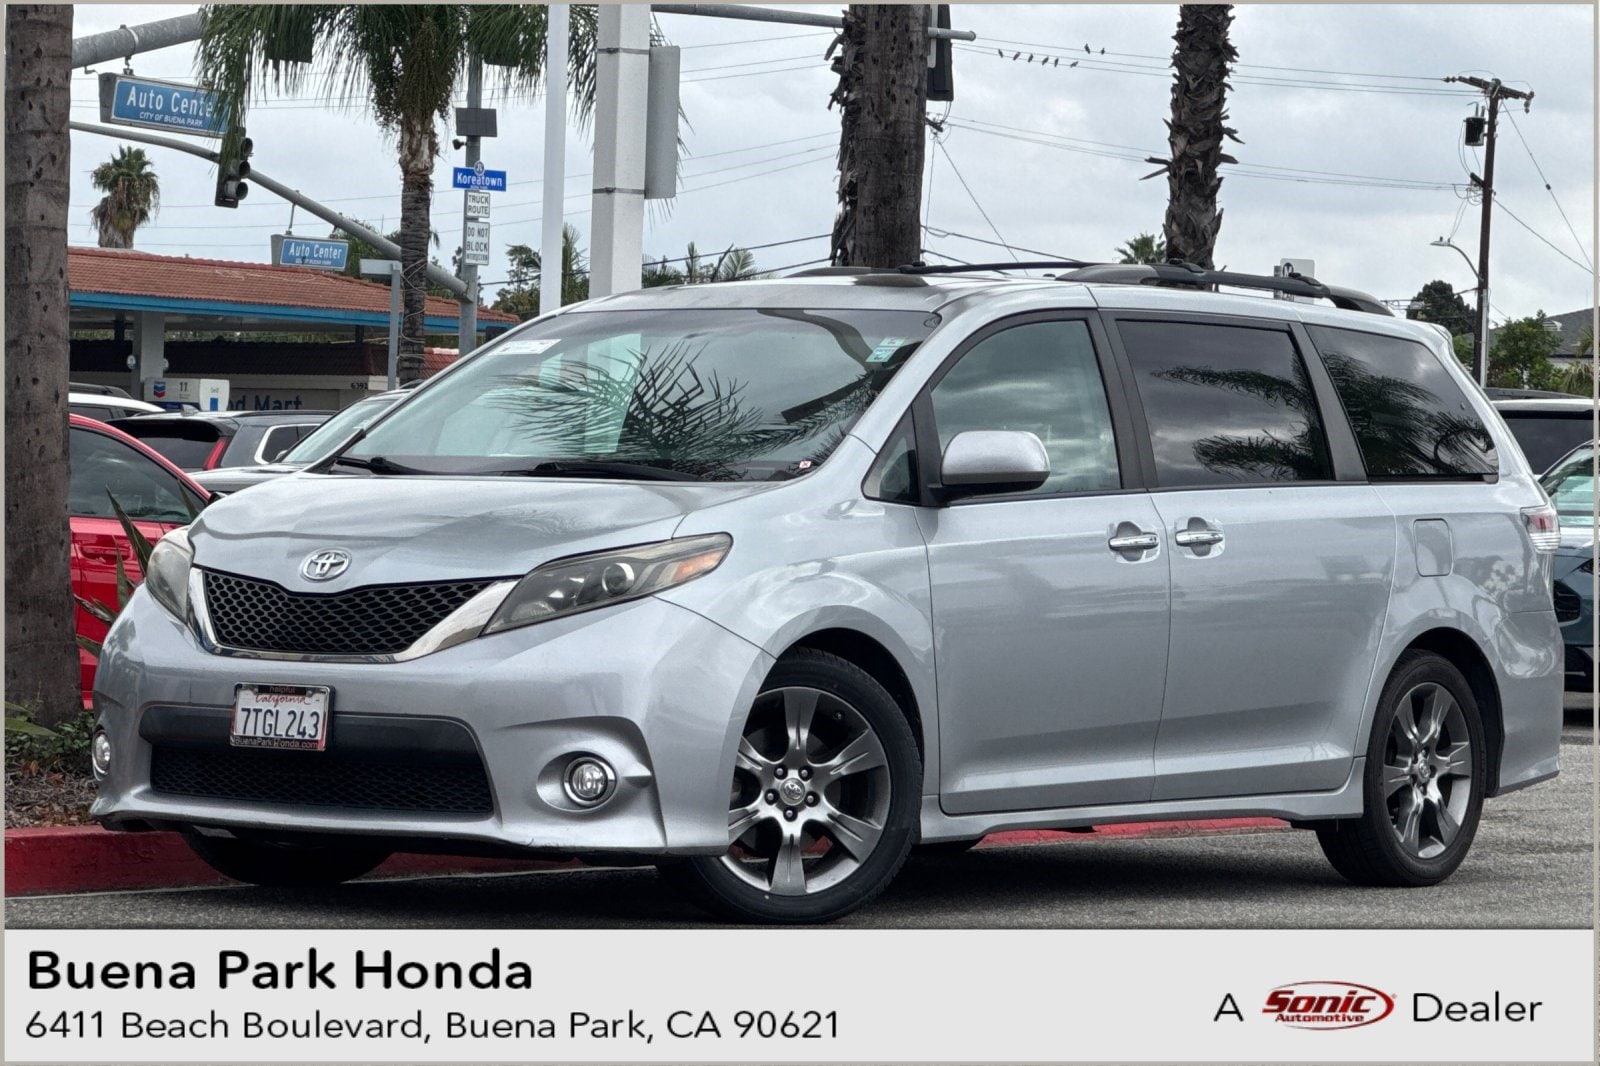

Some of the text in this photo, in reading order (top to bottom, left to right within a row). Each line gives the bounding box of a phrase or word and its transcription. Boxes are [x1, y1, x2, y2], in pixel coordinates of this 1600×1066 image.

[126, 86, 163, 111] Auto
[140, 112, 153, 120] CITY
[164, 116, 185, 124] BUENA
[187, 118, 203, 127] PARK
[457, 172, 503, 187] Koreatown
[468, 194, 489, 204] TRUCK
[467, 205, 489, 215] ROUTE
[467, 227, 488, 238] DO NOT
[288, 242, 342, 259] Auto Center
[466, 241, 488, 252] BLOCK
[254, 395, 302, 411] Mart
[256, 694, 311, 707] California
[241, 707, 320, 739] 7TGL243
